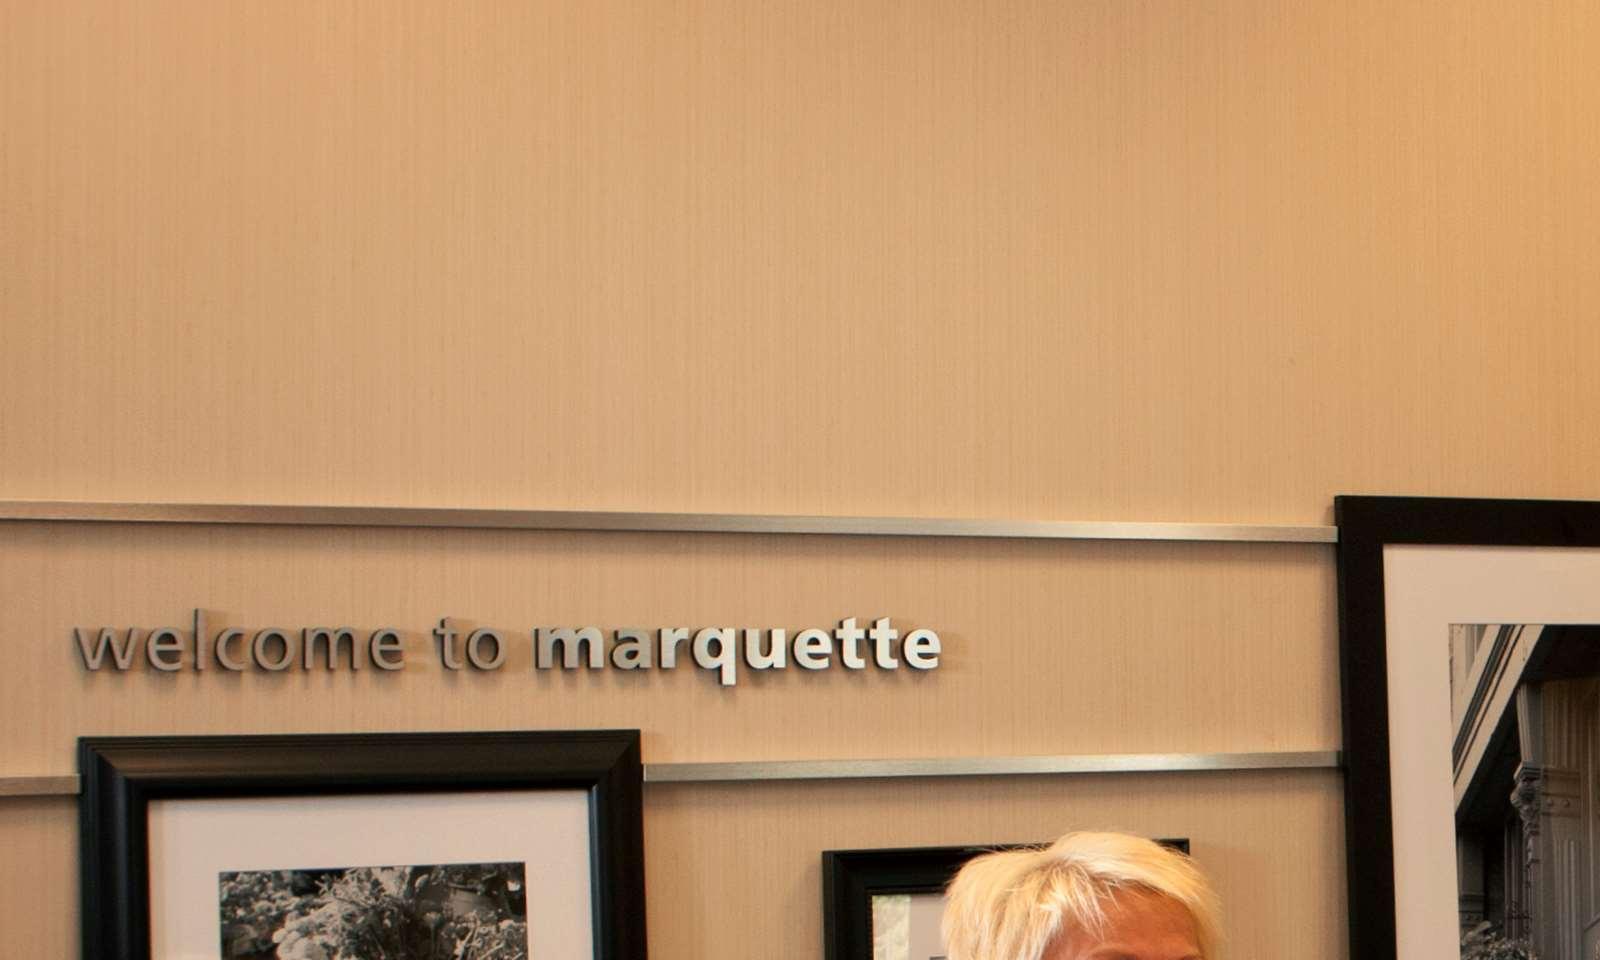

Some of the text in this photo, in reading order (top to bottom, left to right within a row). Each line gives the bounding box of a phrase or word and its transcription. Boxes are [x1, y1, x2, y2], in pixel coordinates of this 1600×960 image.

[74, 608, 942, 686] welcome to marquette
